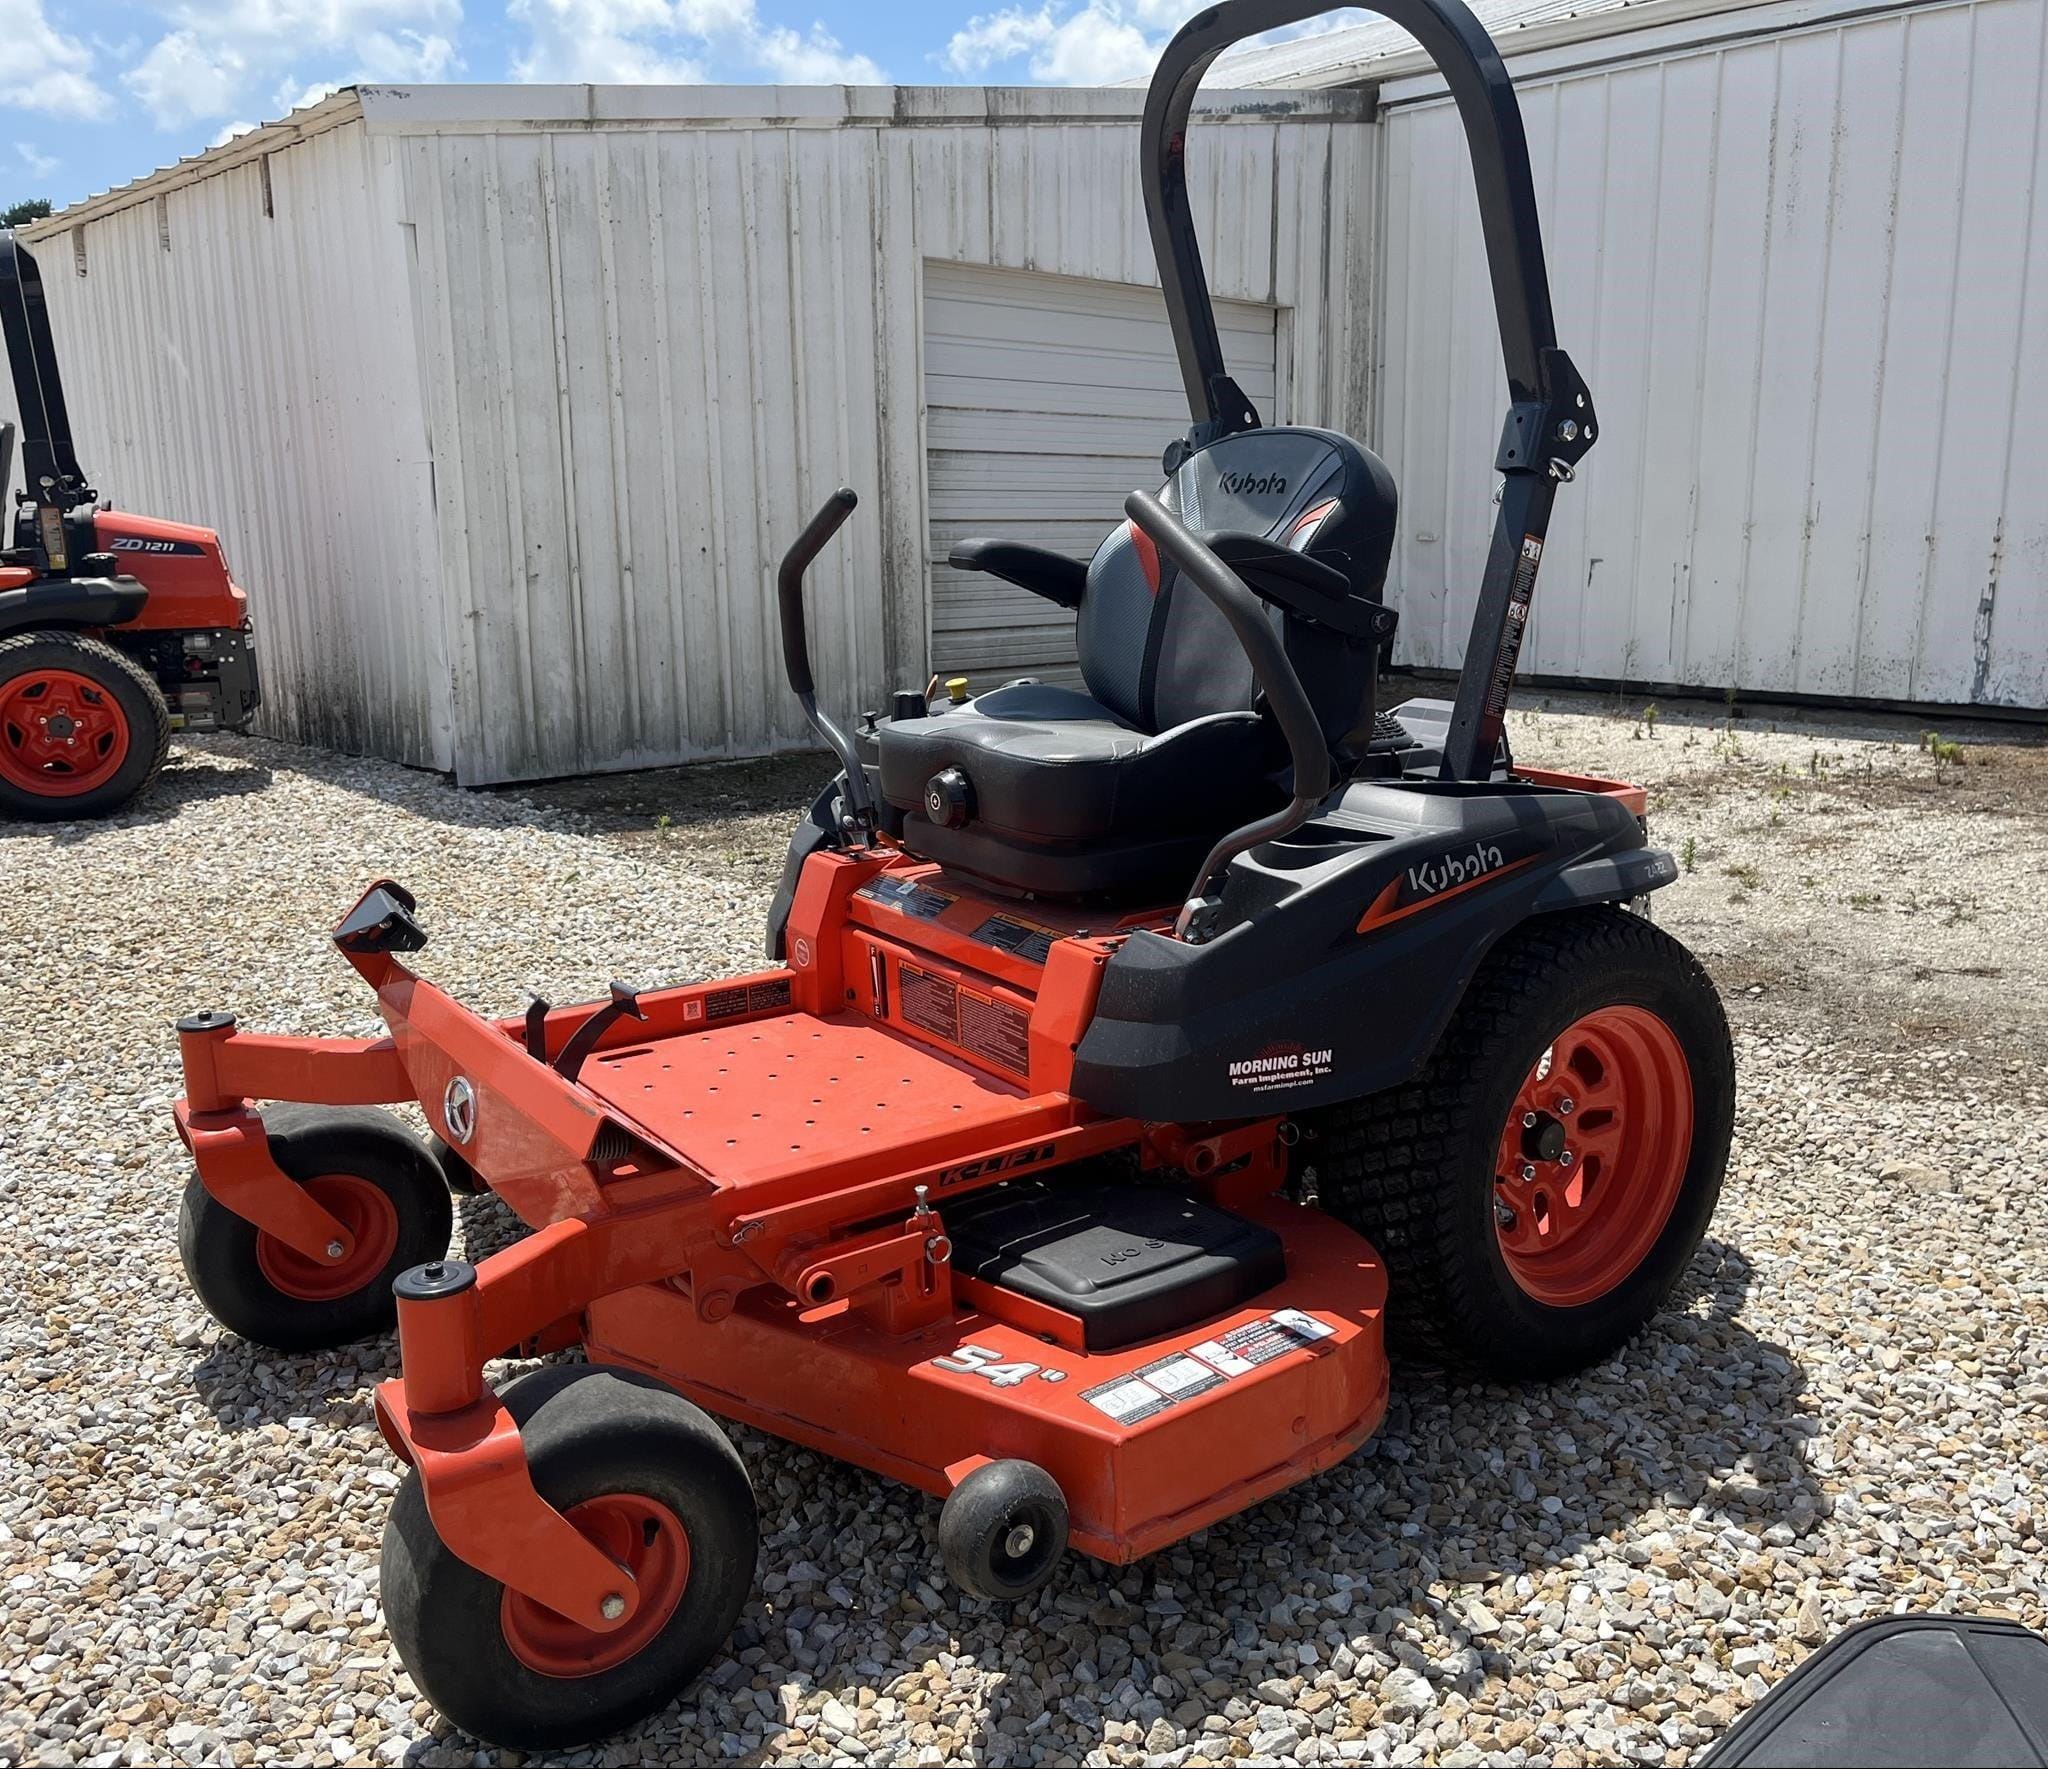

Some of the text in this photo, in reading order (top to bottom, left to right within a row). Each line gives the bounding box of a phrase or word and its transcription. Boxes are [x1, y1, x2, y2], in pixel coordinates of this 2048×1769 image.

[1219, 472, 1287, 494] Kubota
[1408, 842, 1504, 894] Kubota
[1229, 1049, 1332, 1076] MORNING SUN
[1231, 1066, 1332, 1086] Farm Implement, Inc.
[1253, 1079, 1314, 1092] msfarmimpl.com
[942, 1144, 1056, 1185] K-LIFT
